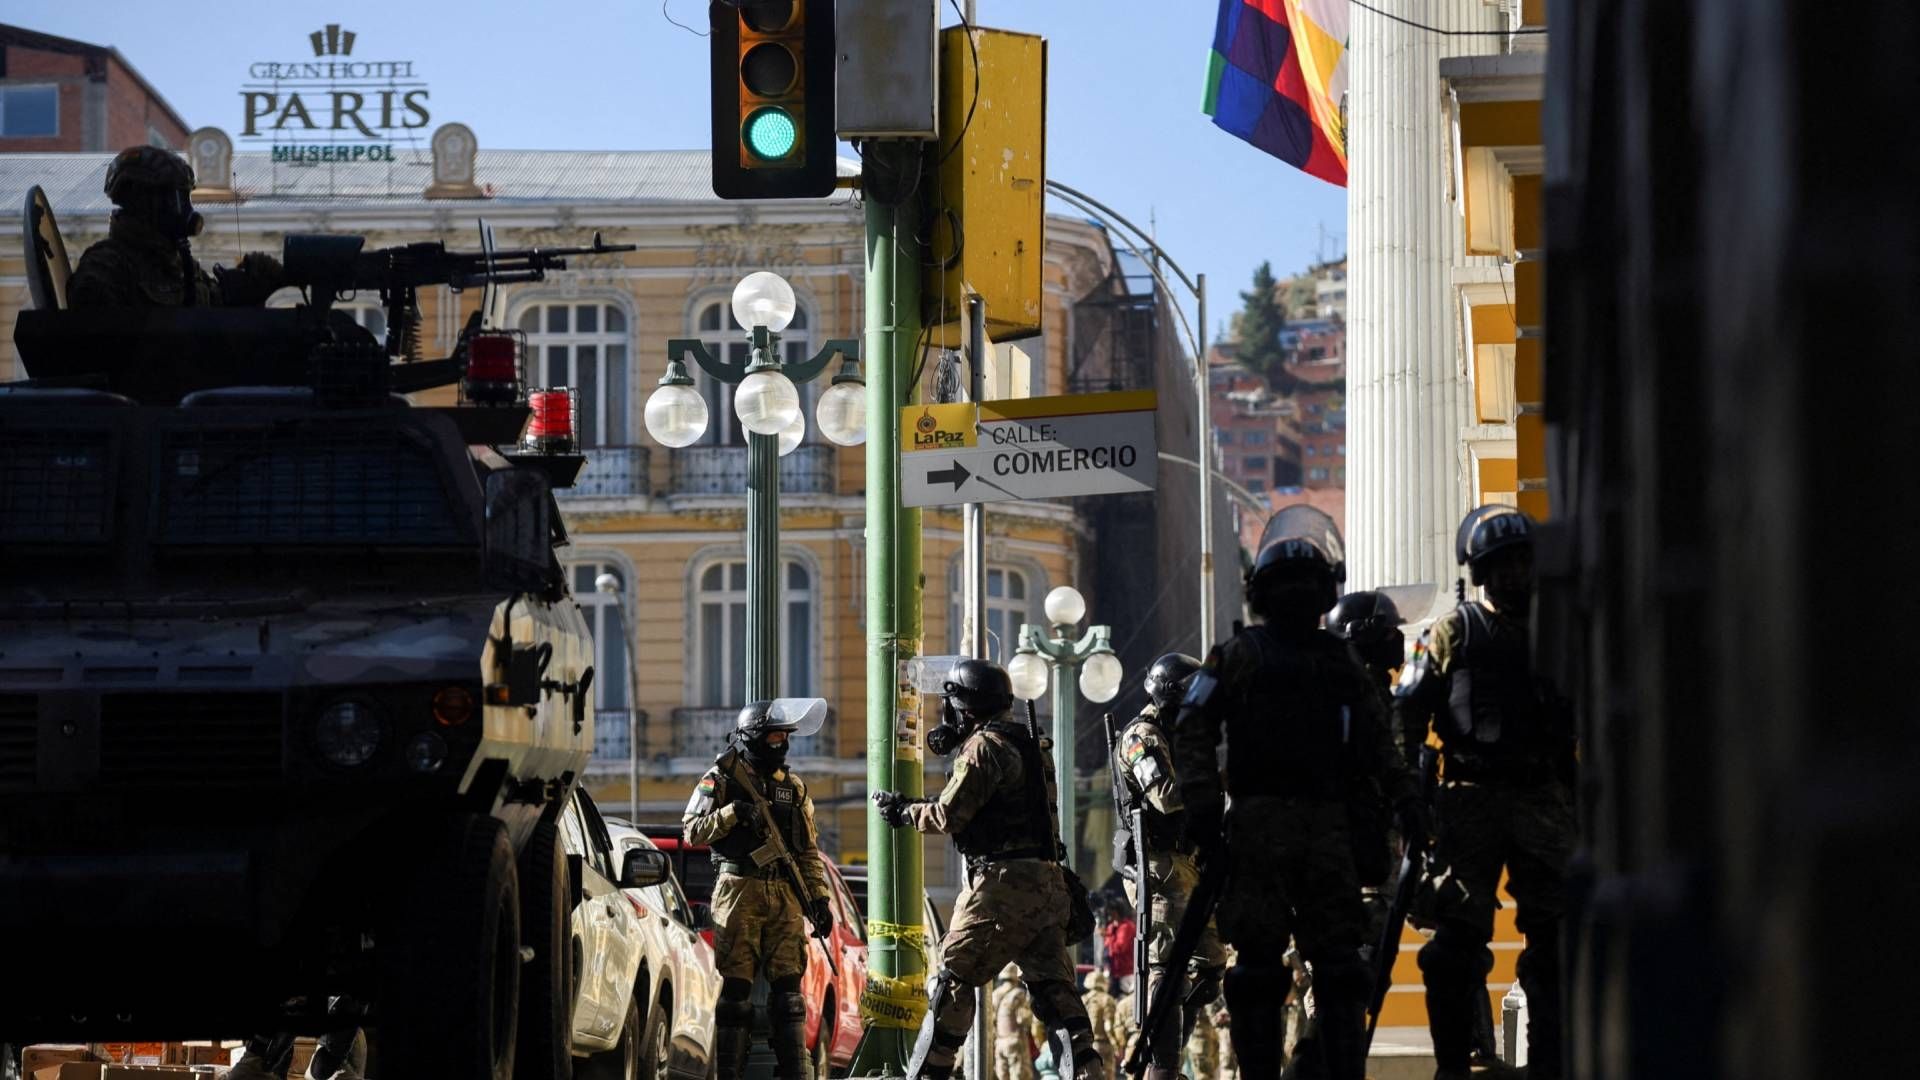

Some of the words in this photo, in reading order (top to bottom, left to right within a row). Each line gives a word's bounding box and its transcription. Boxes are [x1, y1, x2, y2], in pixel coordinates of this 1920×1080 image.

[249, 62, 321, 80] GRAN
[328, 61, 419, 79] HOTEL
[238, 89, 430, 138] PARIS
[271, 144, 397, 162] MUSERPOL
[992, 424, 1057, 445] CALLE:
[993, 445, 1137, 476] COMERCIO
[1492, 516, 1526, 538] PM
